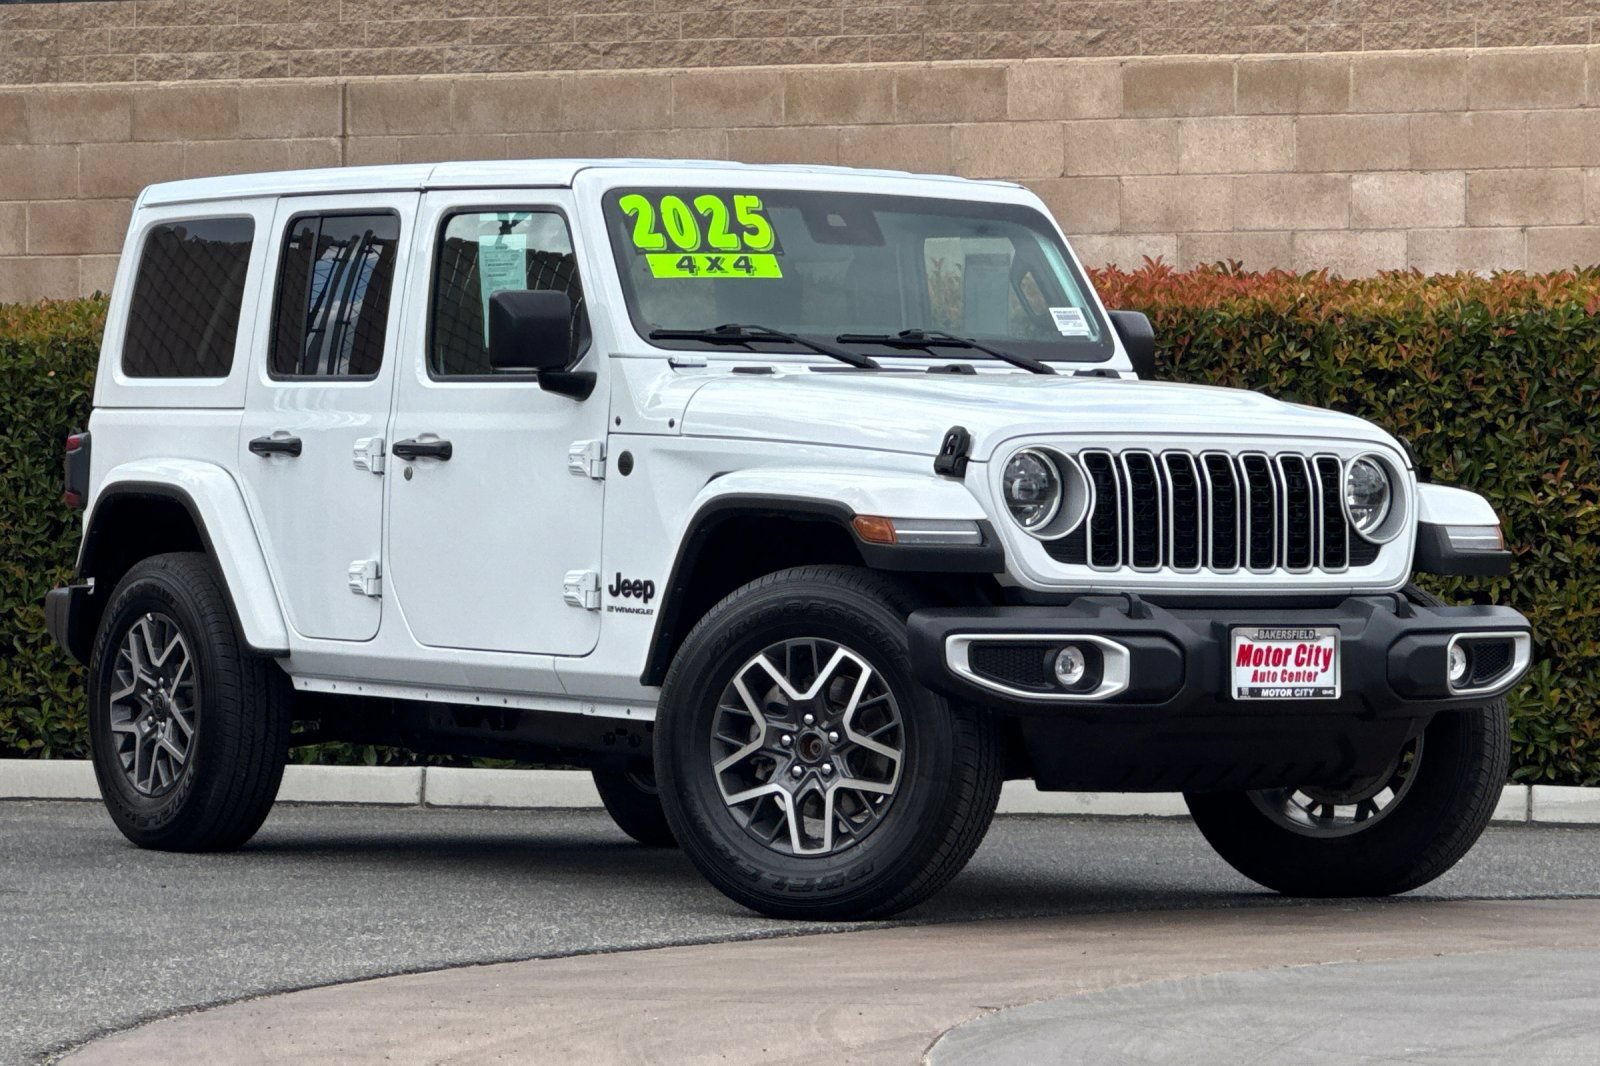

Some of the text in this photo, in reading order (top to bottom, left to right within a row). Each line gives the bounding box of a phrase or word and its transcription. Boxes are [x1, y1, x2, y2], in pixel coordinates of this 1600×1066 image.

[619, 194, 774, 251] 2025
[608, 572, 655, 604] Jeep
[1259, 630, 1314, 640] BAKERSFIELD
[1236, 643, 1333, 673] Motor City
[1251, 669, 1318, 683] Auto Center
[1261, 688, 1315, 697] MOTOR CITY
